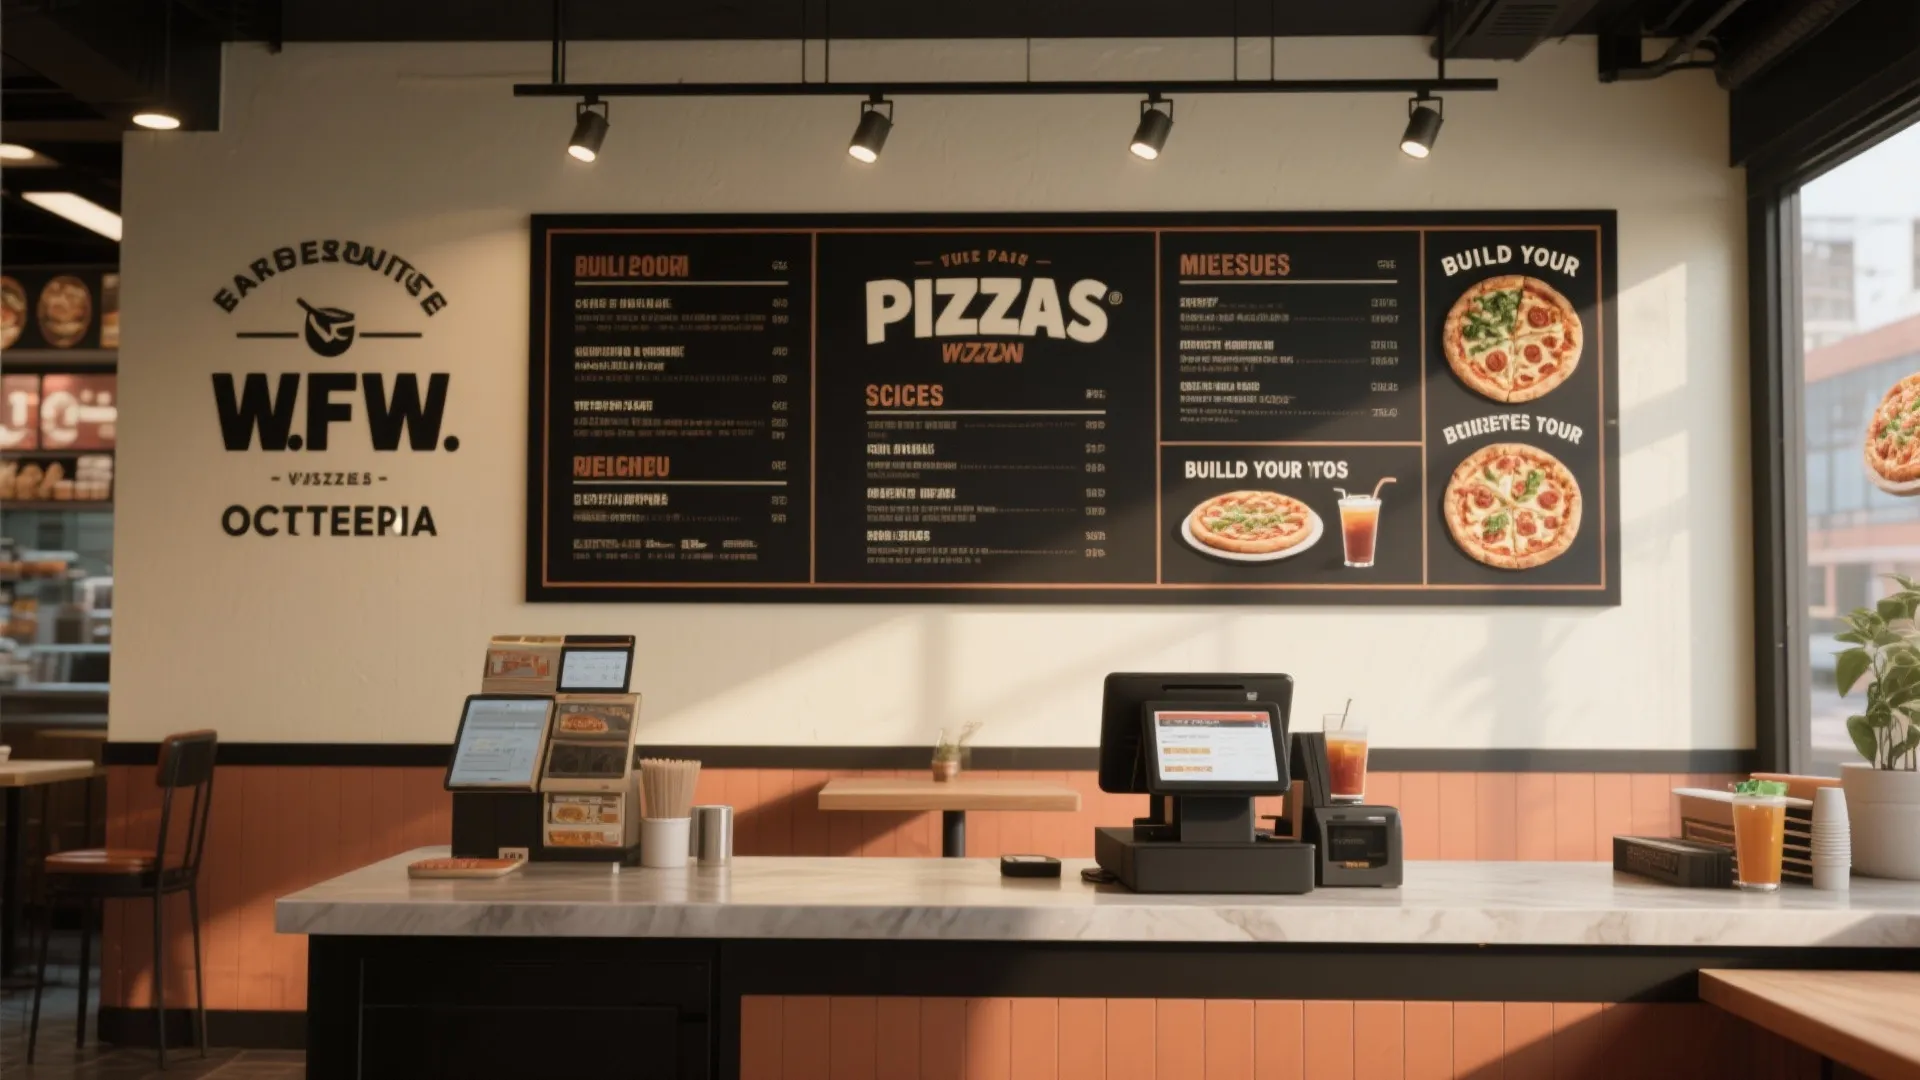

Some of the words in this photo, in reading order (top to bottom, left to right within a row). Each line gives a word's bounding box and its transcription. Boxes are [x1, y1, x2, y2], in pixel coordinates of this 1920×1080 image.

[1441, 245, 1512, 276] BUILD
[1520, 246, 1580, 277] YOUR
[866, 384, 944, 407] SCICES
[1184, 460, 1248, 479] BUILLD
[1253, 460, 1302, 479] YOUR
